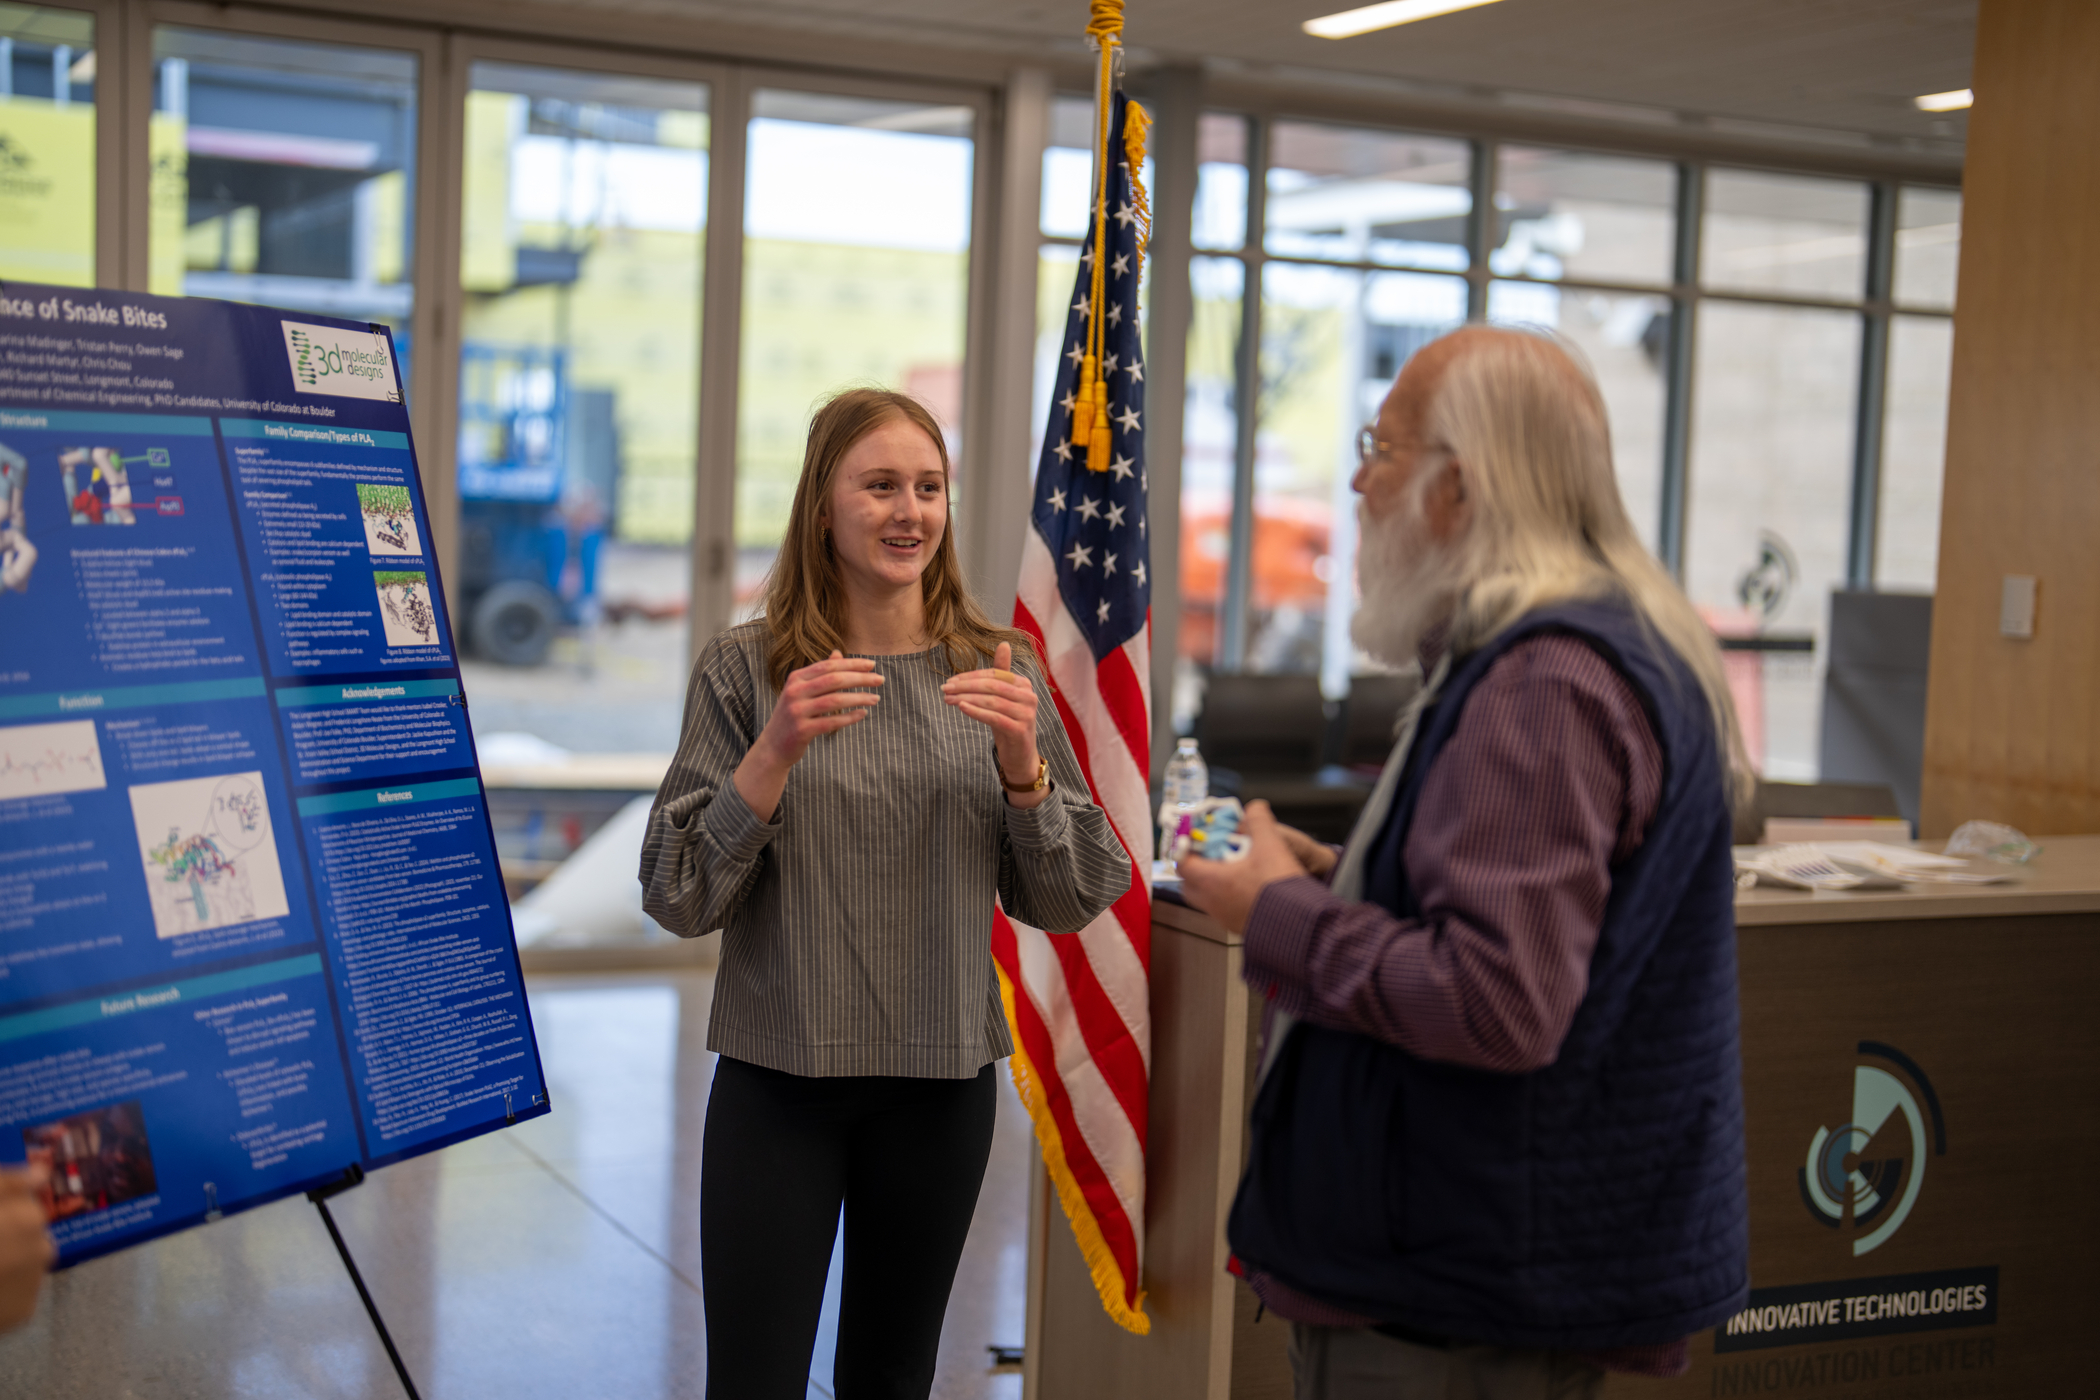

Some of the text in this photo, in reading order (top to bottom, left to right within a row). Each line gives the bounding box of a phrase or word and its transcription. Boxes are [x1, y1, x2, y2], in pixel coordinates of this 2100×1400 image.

[38, 297, 60, 319] of
[62, 299, 119, 326] Snake
[122, 305, 168, 329] Bites
[314, 343, 388, 376] 3d molecular
[347, 364, 384, 381] designs
[310, 405, 337, 419] Boulder
[264, 425, 288, 439] Family
[350, 432, 359, 442] of
[341, 685, 406, 701] Acknowledgements
[377, 789, 414, 804] References
[1726, 1284, 1987, 1336] INNOVATIVE TECHNOLOGIES
[1711, 1336, 1996, 1398] INNOVATION CENTER
